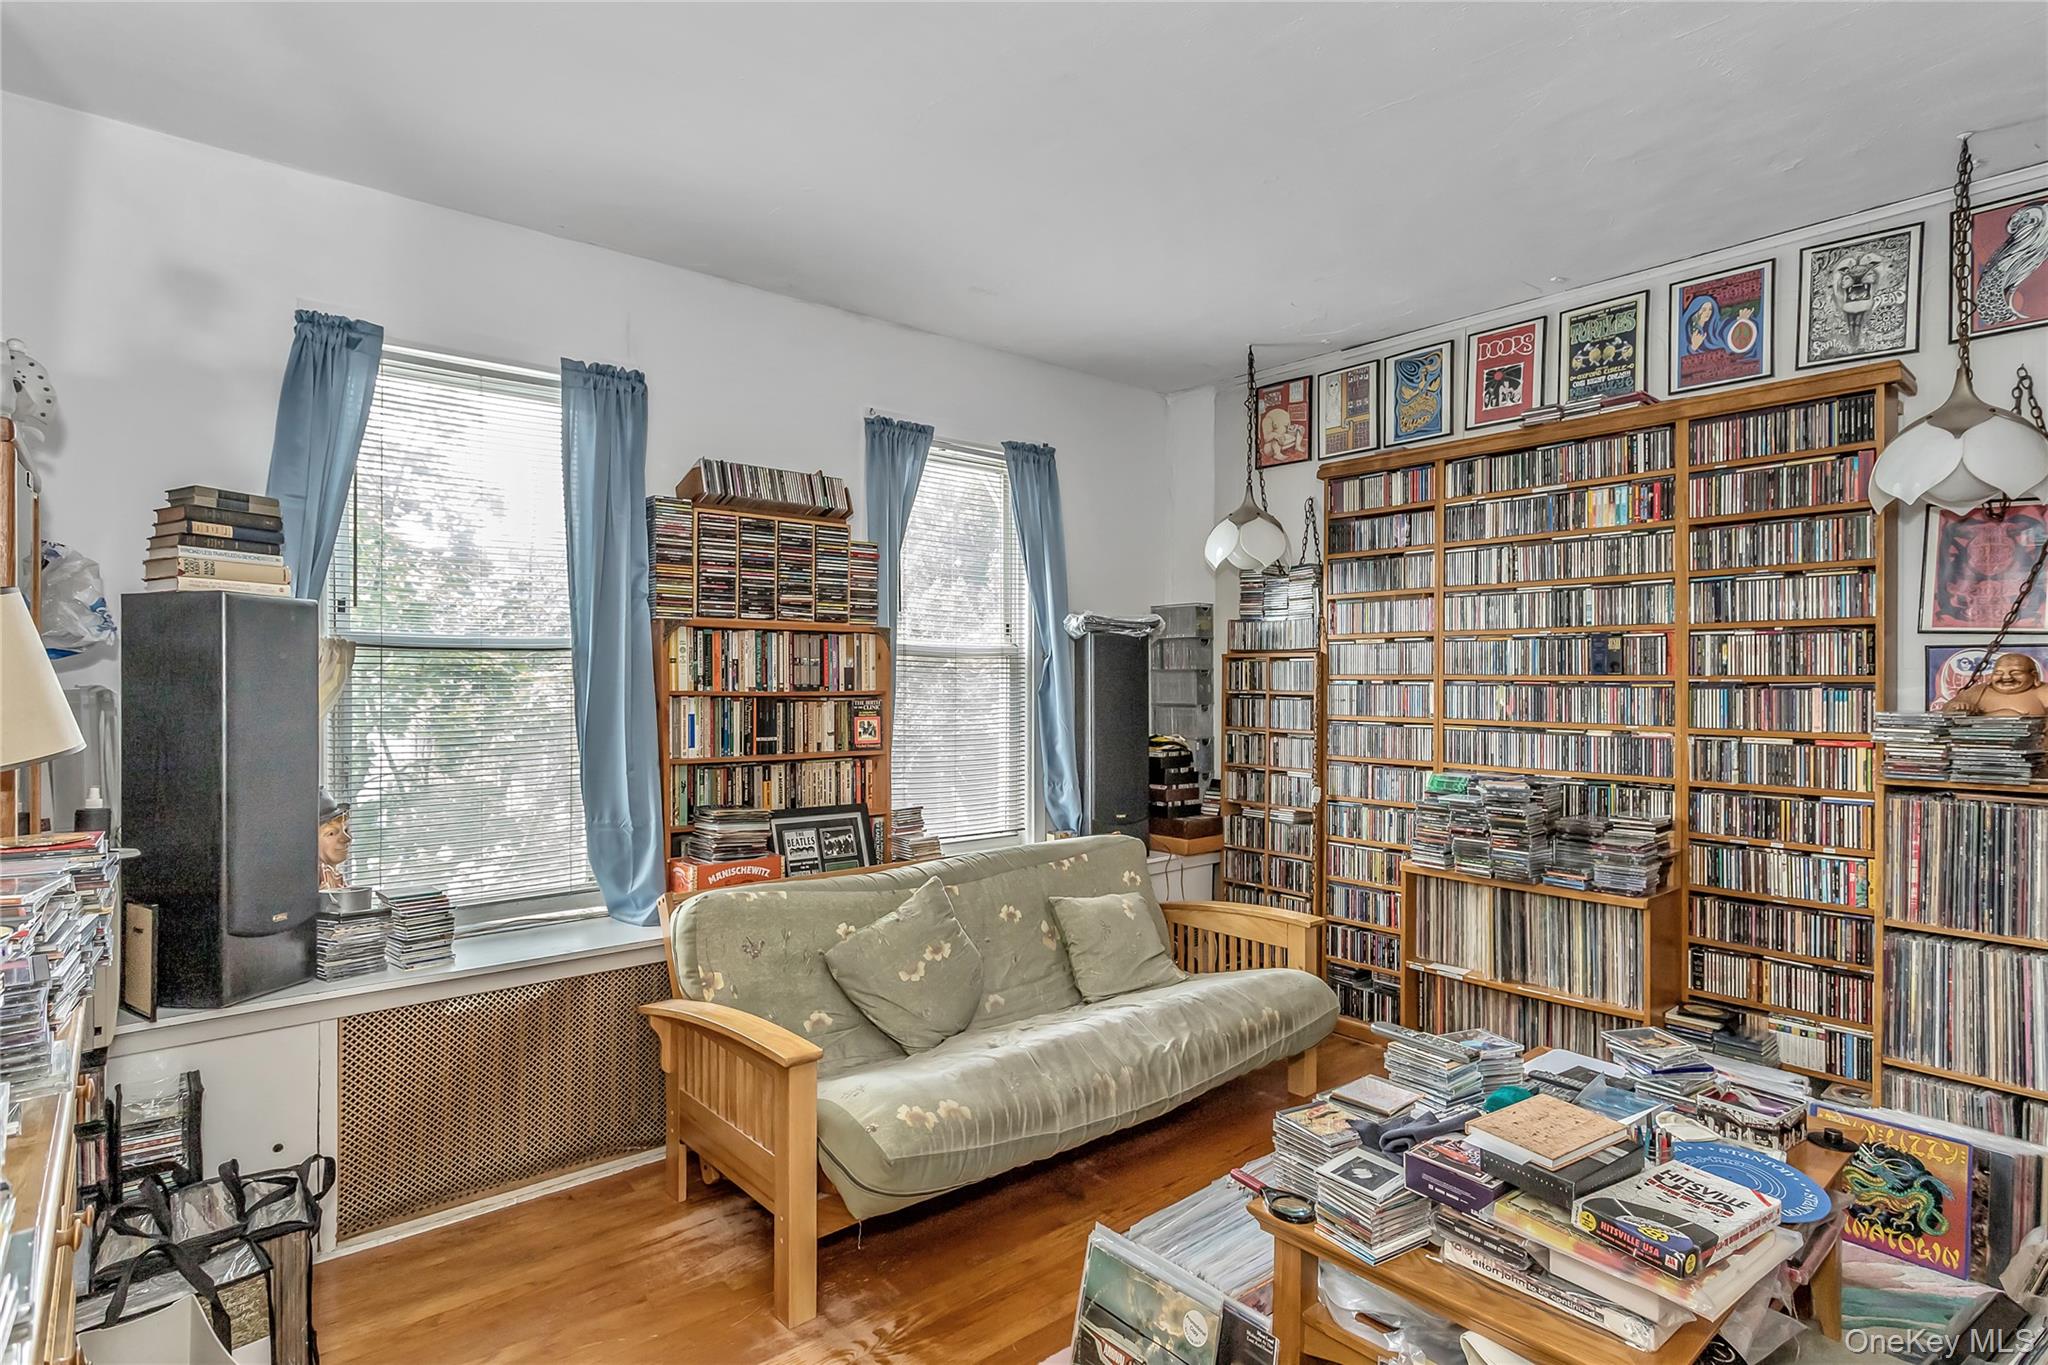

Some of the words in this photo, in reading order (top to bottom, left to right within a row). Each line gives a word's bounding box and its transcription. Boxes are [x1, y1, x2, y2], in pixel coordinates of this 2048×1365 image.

[1570, 309, 1637, 345] TURTLES
[1478, 333, 1535, 361] DOORS
[786, 836, 816, 848] BEATLES
[707, 865, 771, 885] MANISCHEWITZ
[1886, 1128, 1959, 1165] LIZZY
[1652, 1174, 1735, 1214] USA
[1660, 1168, 1751, 1210] HITSVILLE
[1600, 1221, 1640, 1248] HITSVILLE
[1642, 1242, 1660, 1258] USA
[1844, 1215, 1960, 1270] INATOWN
[1472, 1258, 1500, 1276] elton
[1500, 1269, 1527, 1289] john
[1527, 1282, 1537, 1292] to
[1538, 1288, 1549, 1298] be
